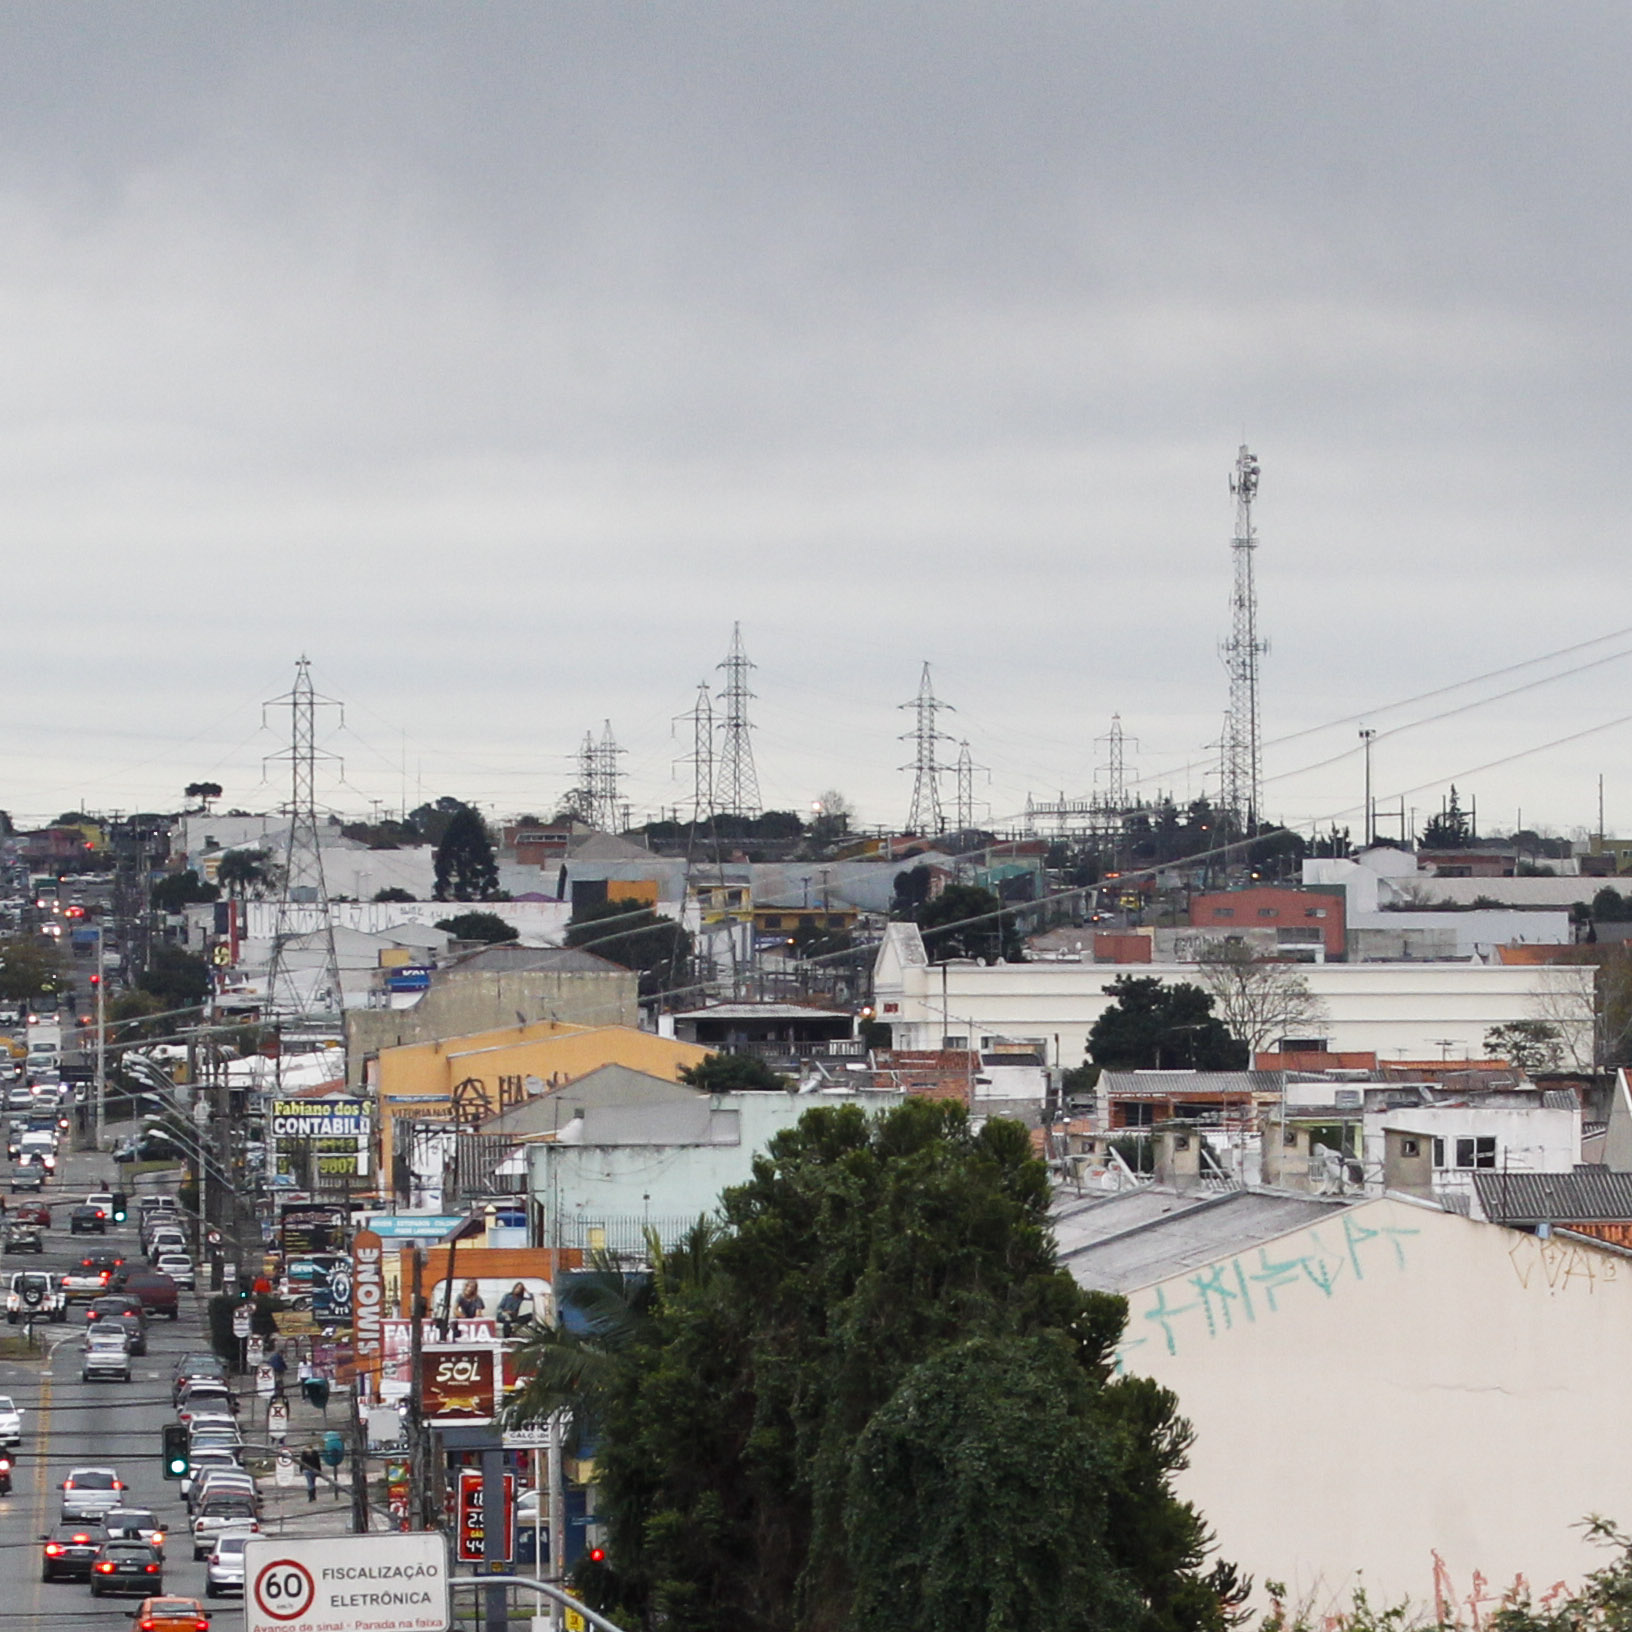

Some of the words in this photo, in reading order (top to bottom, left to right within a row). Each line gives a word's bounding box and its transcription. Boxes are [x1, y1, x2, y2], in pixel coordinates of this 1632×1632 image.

[273, 1101, 331, 1116] Fabiano
[334, 1101, 360, 1116] dos
[362, 1100, 372, 1116] S
[357, 1248, 380, 1356] SIMONE
[435, 1361, 481, 1382] SOL
[265, 1572, 303, 1599] 60
[321, 1562, 438, 1581] FISCALIZAÇÃO
[330, 1589, 432, 1607] ELETRÔNICA
[299, 1623, 314, 1632] de
[317, 1621, 344, 1631] sinal
[355, 1619, 396, 1631] Parada
[399, 1620, 414, 1629] na
[415, 1618, 443, 1628] faixa
